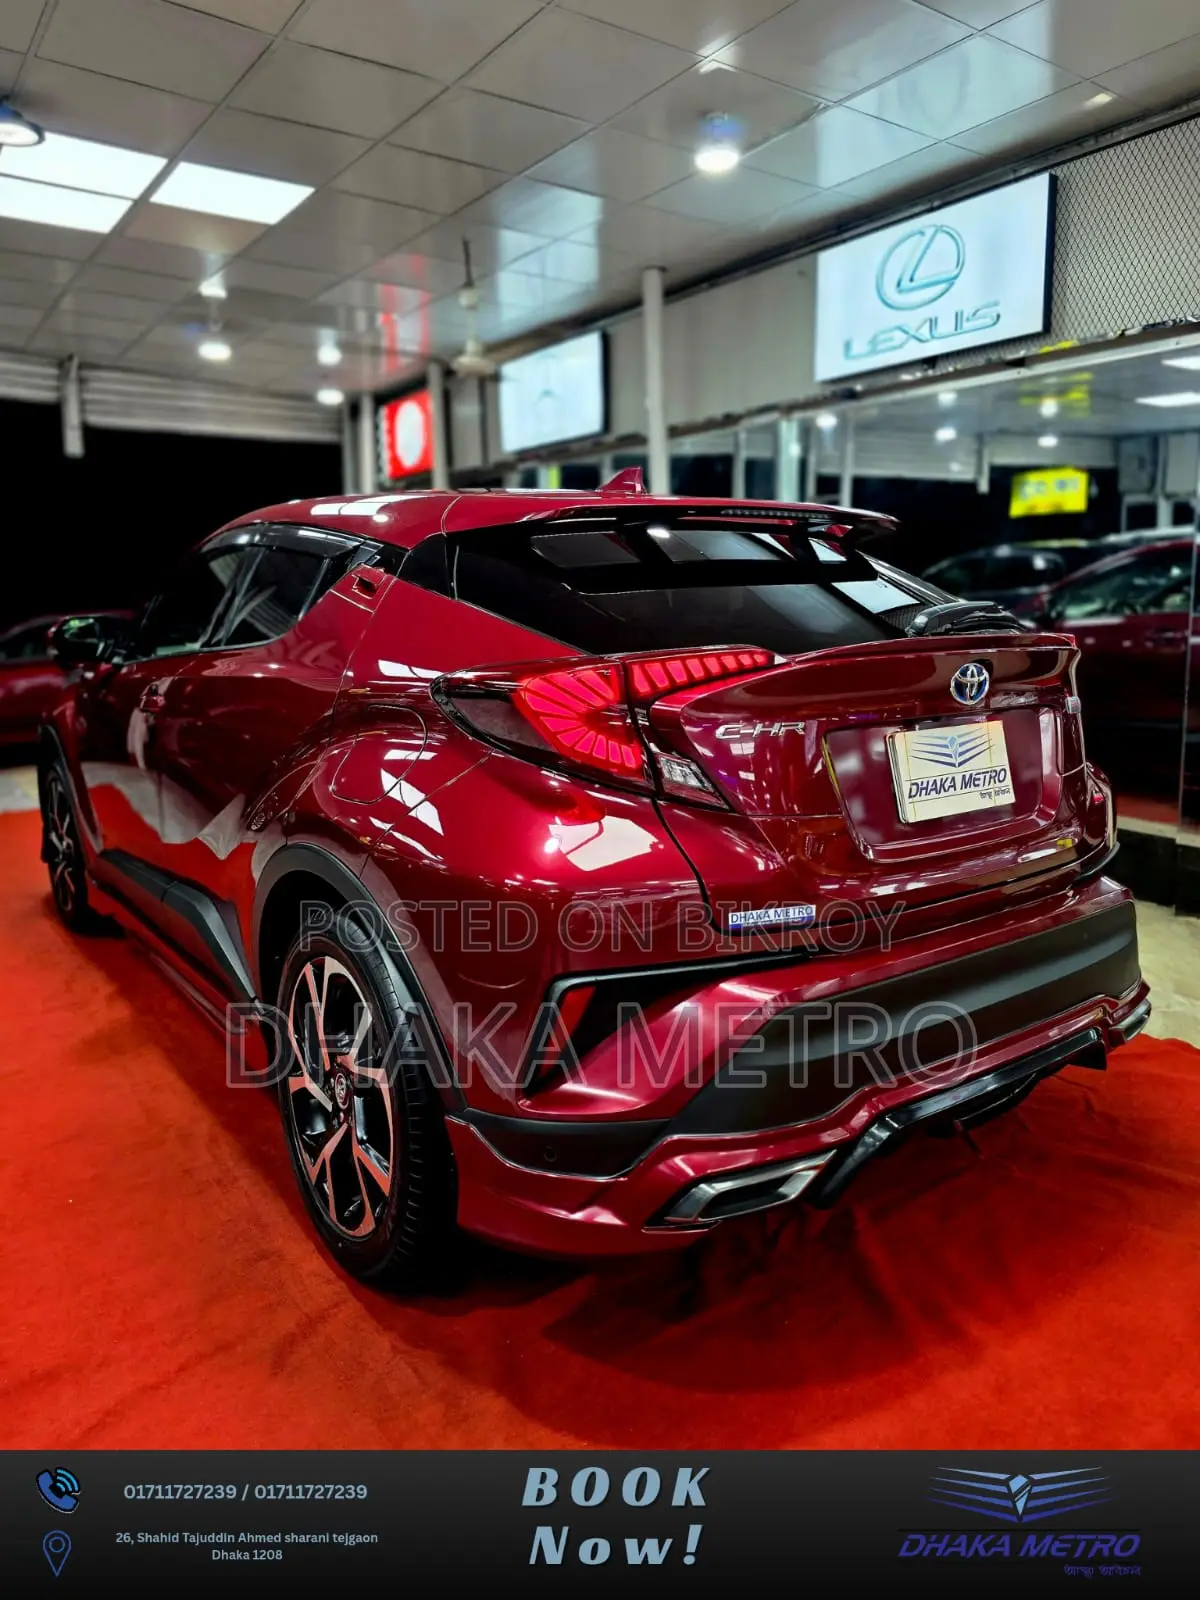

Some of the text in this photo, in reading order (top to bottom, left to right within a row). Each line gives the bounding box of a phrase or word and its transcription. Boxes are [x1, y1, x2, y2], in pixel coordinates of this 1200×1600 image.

[843, 302, 1001, 361] LEXUS
[715, 721, 805, 739] C-HR
[908, 776, 957, 799] DHAKA
[960, 768, 1007, 790] METRO
[731, 910, 770, 923] DHAKA
[774, 906, 813, 918] METRO
